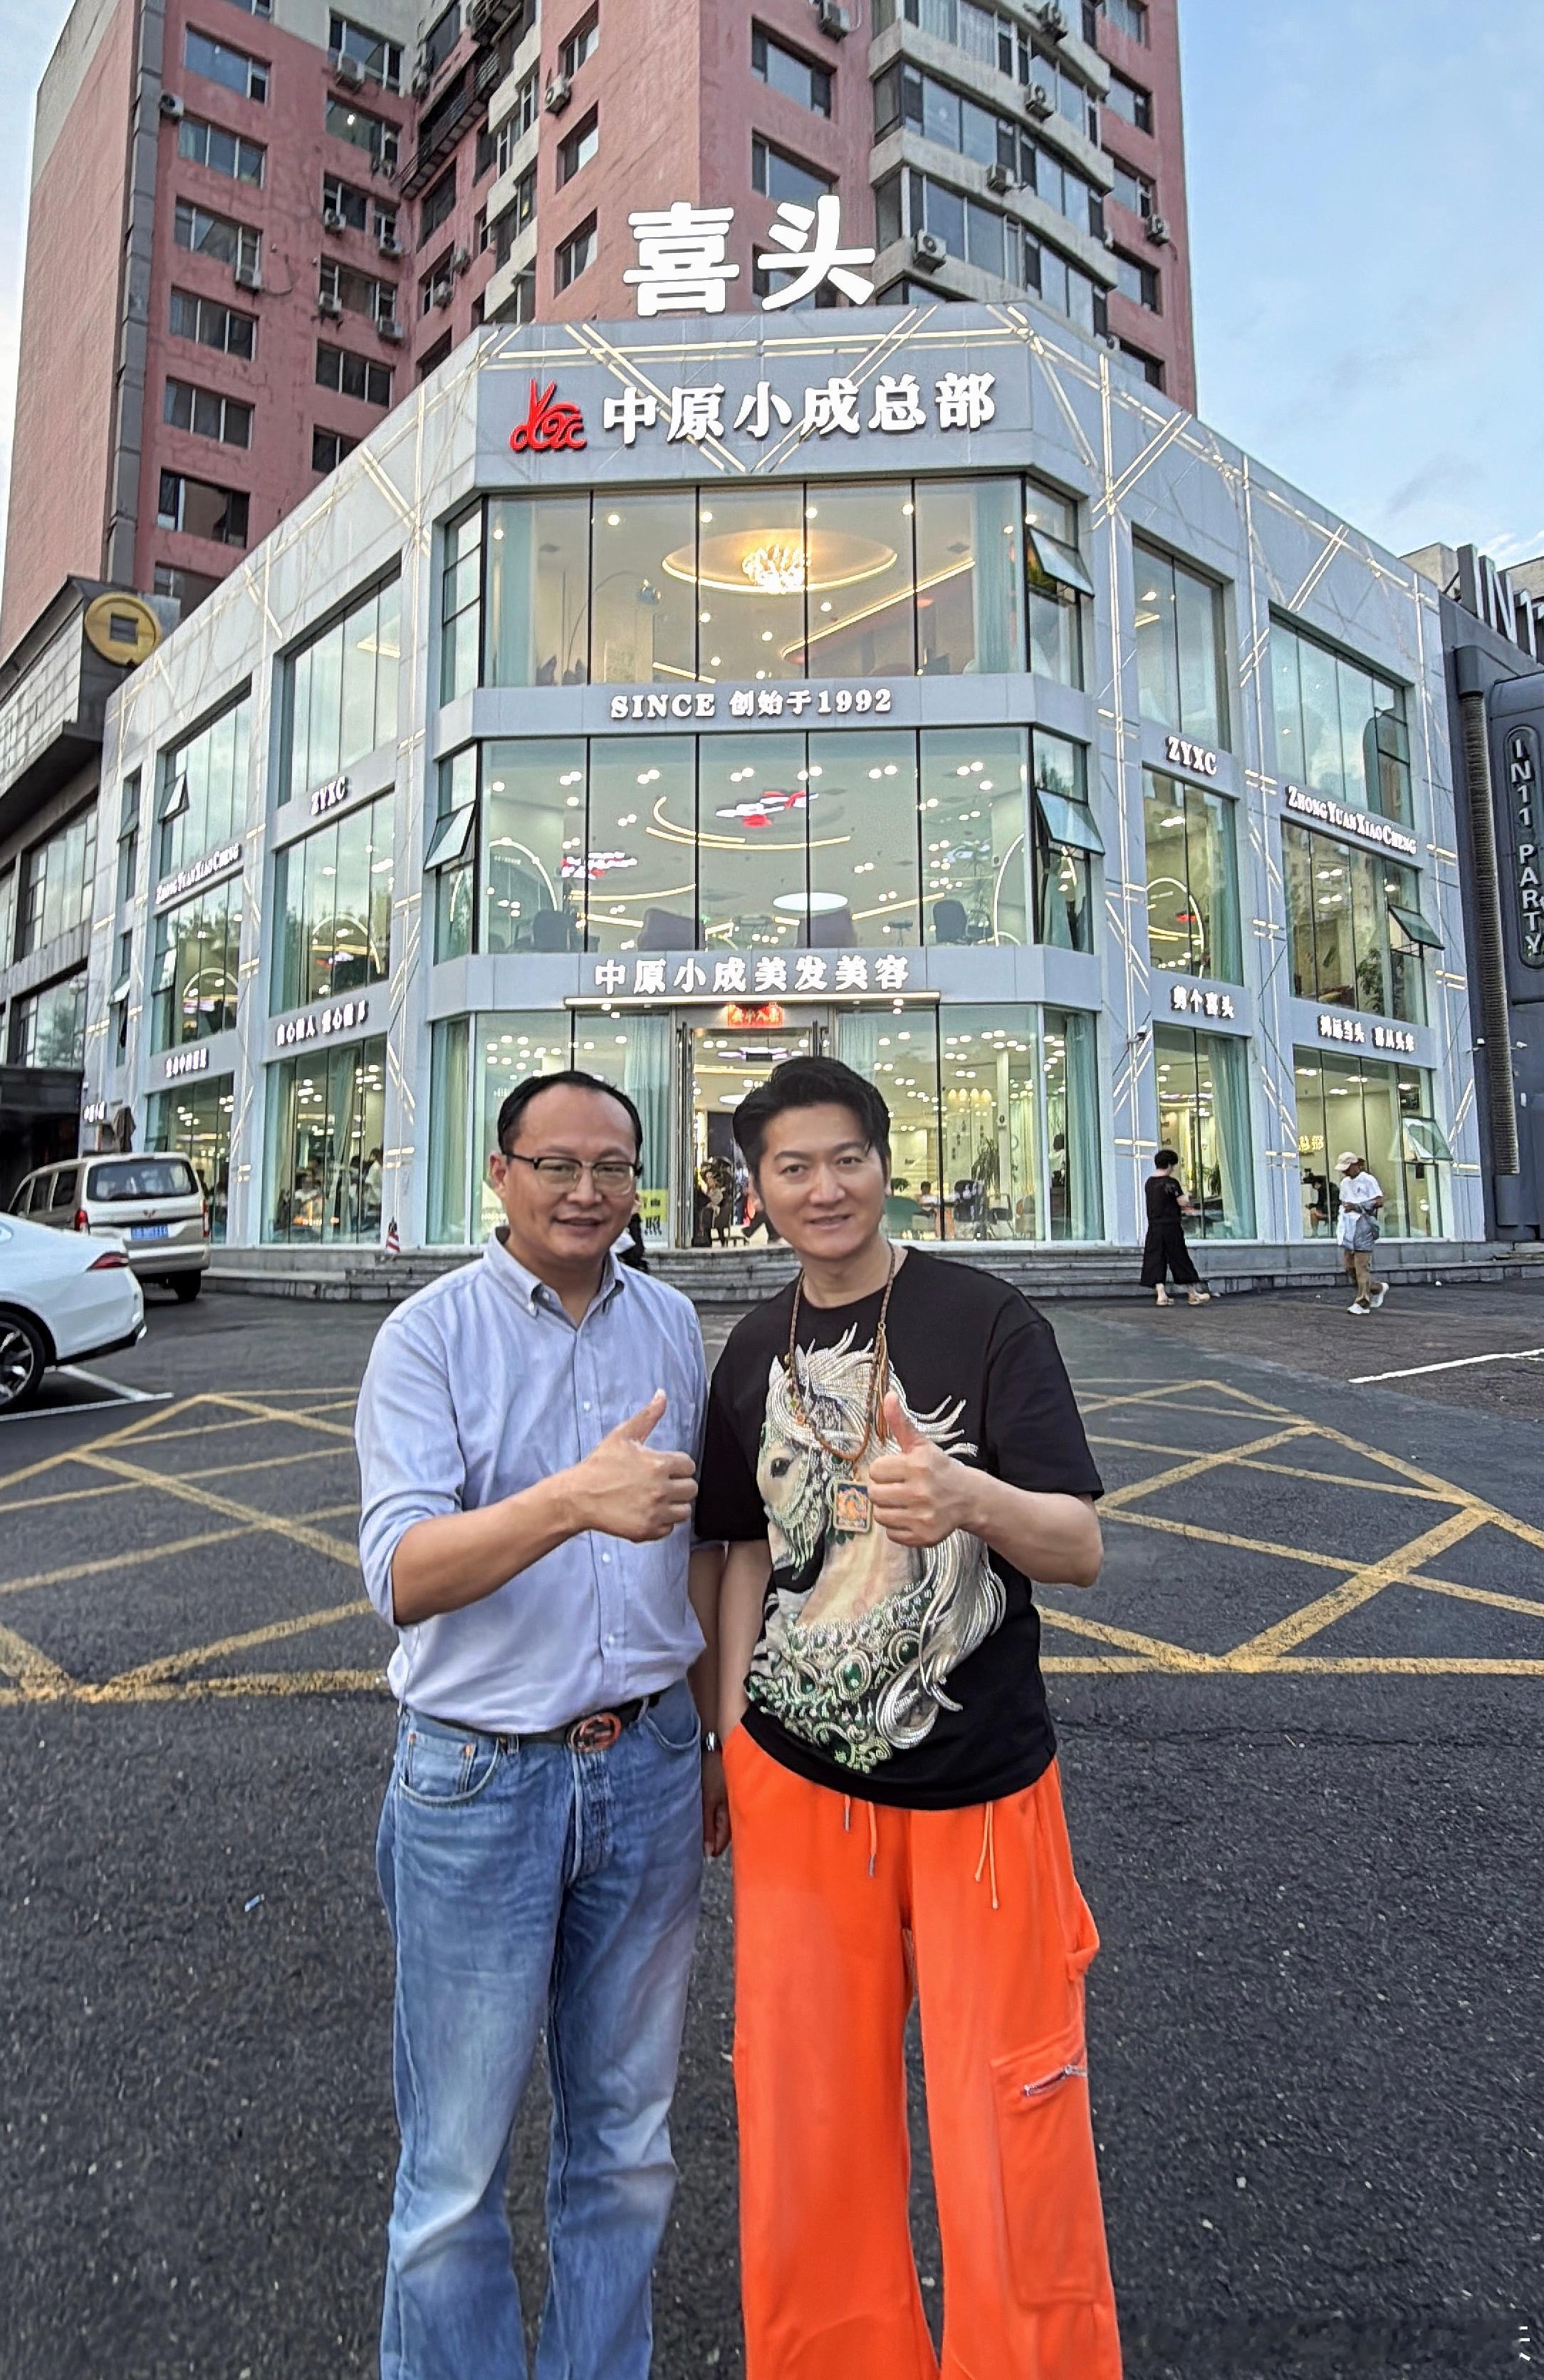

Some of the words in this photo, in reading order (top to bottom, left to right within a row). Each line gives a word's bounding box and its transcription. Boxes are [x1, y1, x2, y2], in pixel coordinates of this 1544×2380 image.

[623, 194, 875, 317] 喜头
[603, 371, 997, 446] 中原小成总部
[610, 693, 715, 719] SINCE
[729, 688, 892, 716] 创始于1992
[1168, 736, 1217, 775] ZYXC
[1518, 843, 1542, 955] PARTY
[594, 953, 910, 995] 中原小成美发美容
